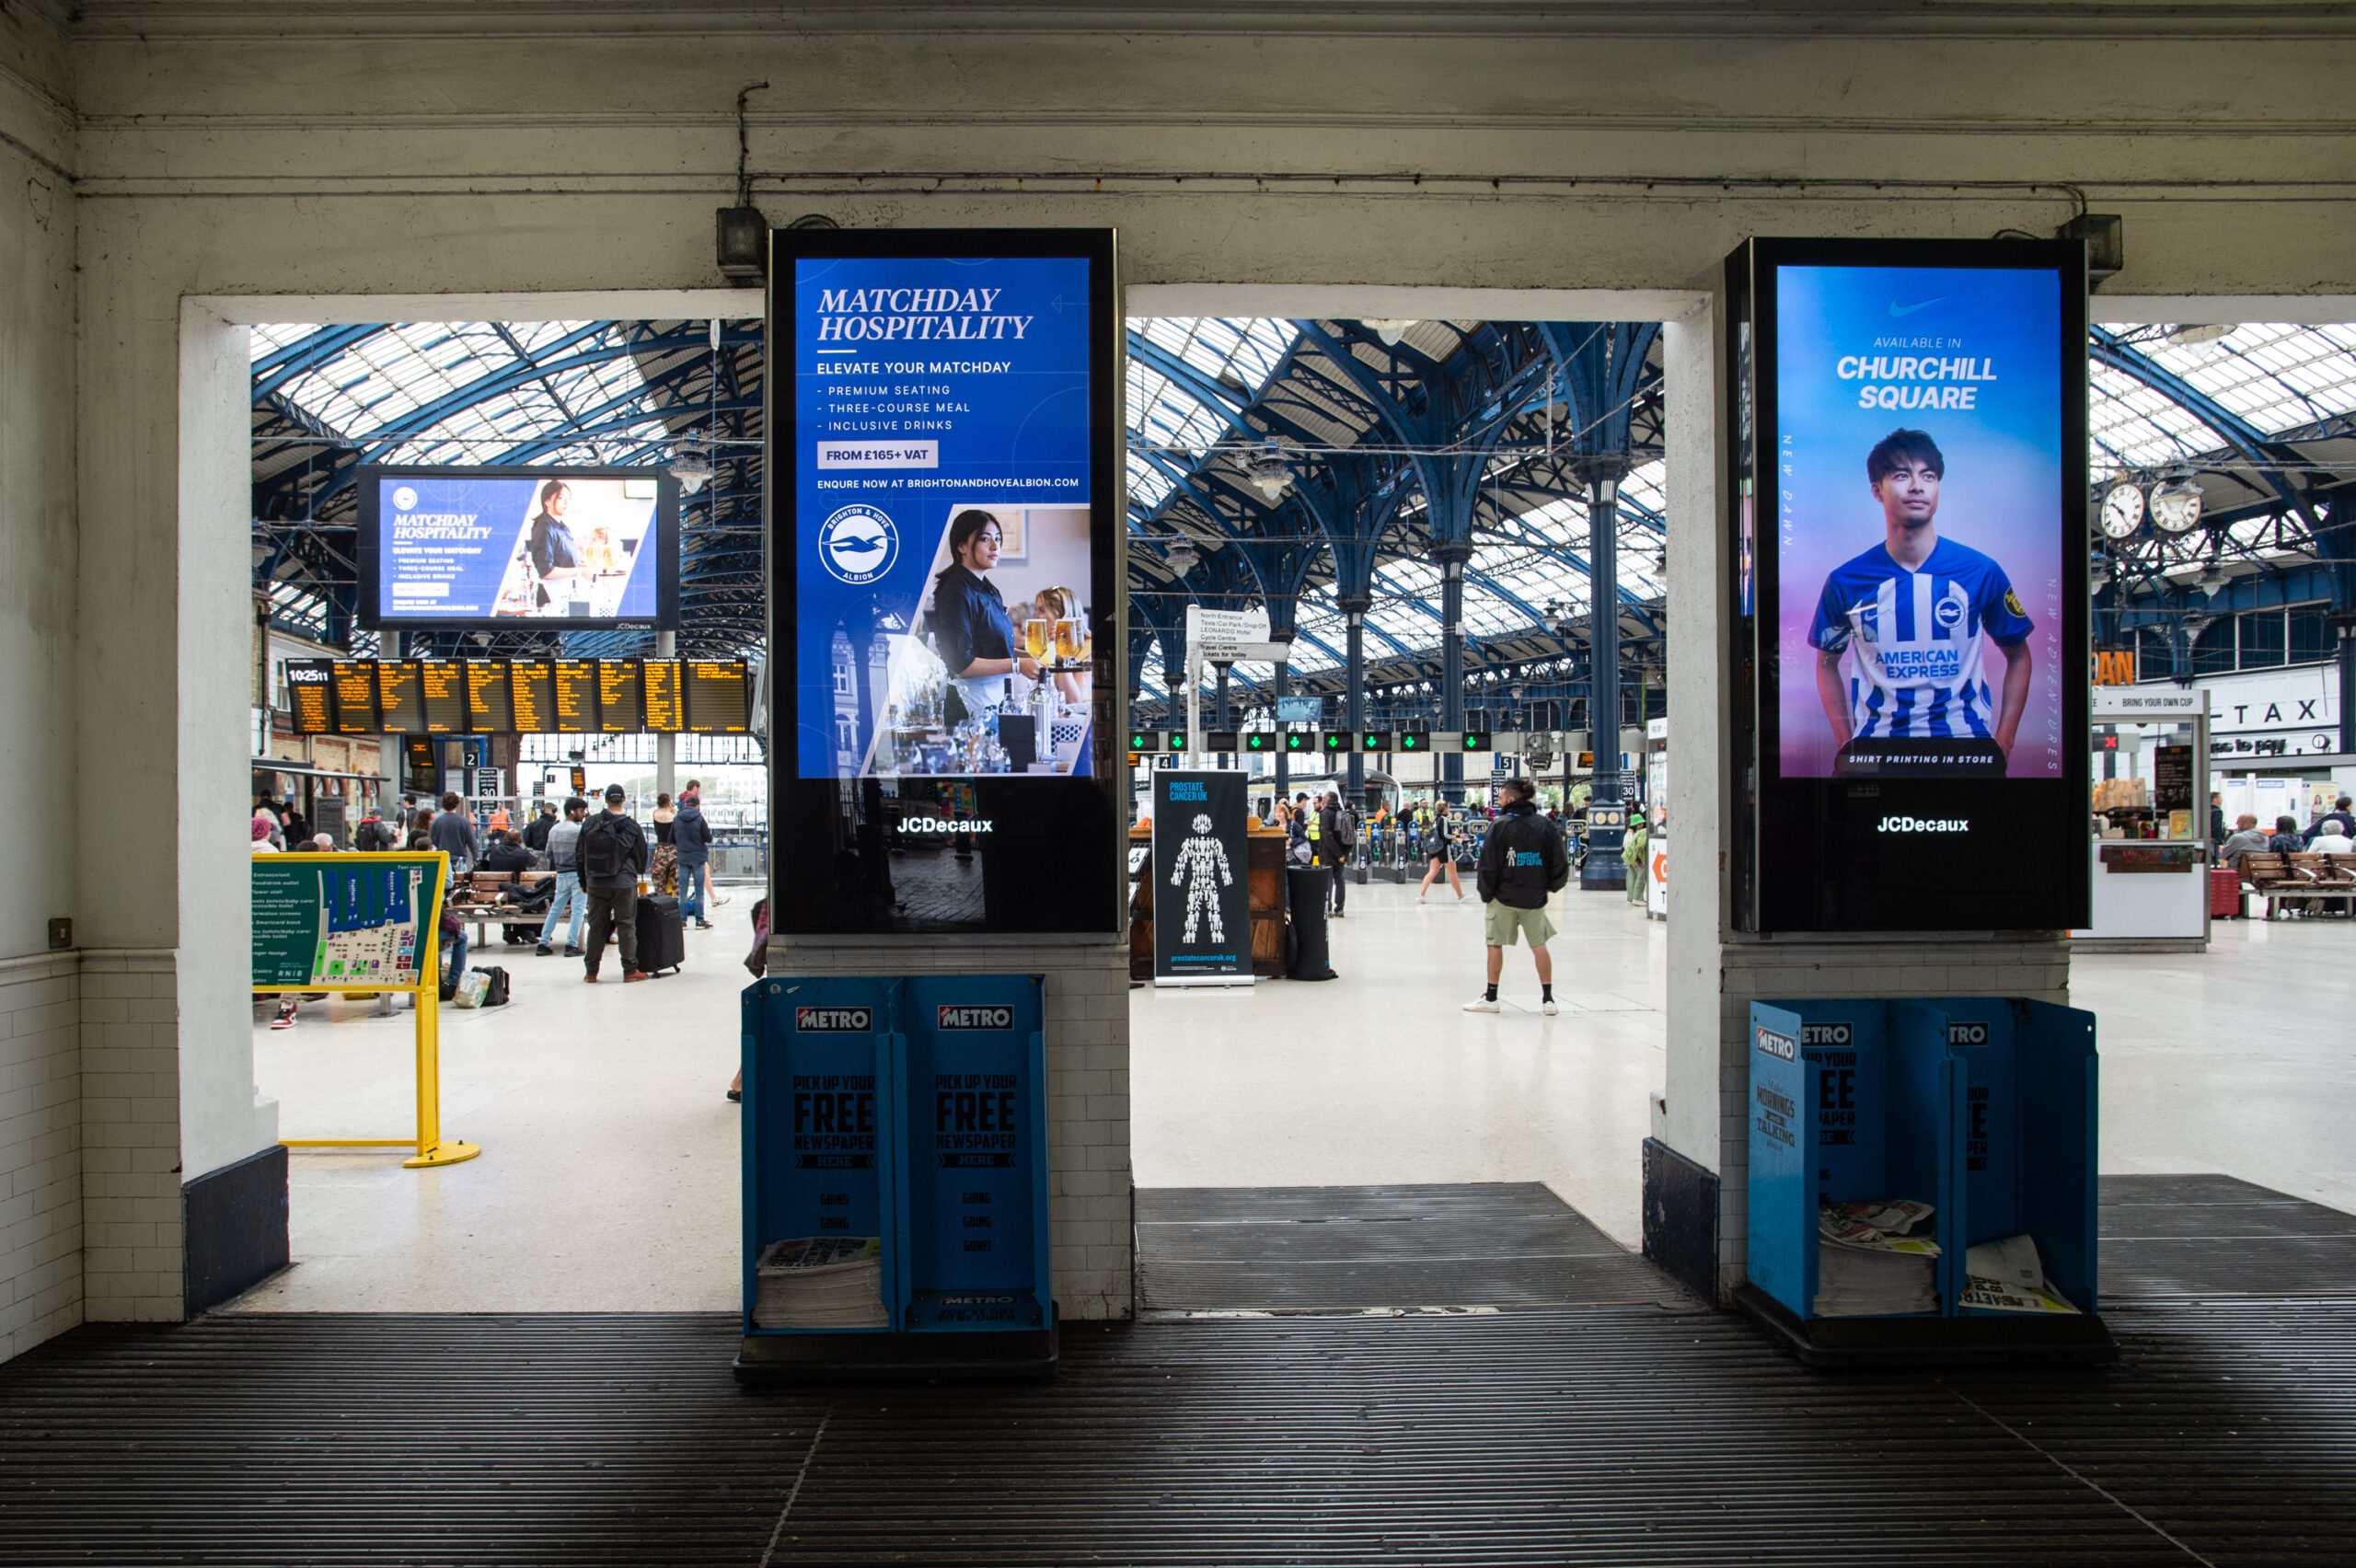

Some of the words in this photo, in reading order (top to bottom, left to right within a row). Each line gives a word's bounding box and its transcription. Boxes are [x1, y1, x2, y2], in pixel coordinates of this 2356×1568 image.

[816, 288, 1000, 313] MATCHDAY
[817, 316, 1034, 340] HOSPITALITY
[1874, 337, 1943, 348] AVAILABLE
[1947, 338, 1961, 348] IN
[817, 363, 879, 375] ELEVATE
[884, 362, 925, 375] YOUR
[930, 361, 1011, 374] MATCHDAY
[1837, 356, 1997, 380] CHURCHILL
[828, 386, 888, 396] PREMIUM
[895, 386, 951, 396] SEATING
[1858, 386, 1978, 409] SQUARE
[828, 403, 930, 413] THREE-COURSE
[936, 402, 970, 412] MEAL
[828, 421, 898, 431] INCLUSIVE
[904, 421, 953, 431] DRINKS
[826, 450, 862, 461] FROM
[864, 450, 901, 461] £165+
[904, 449, 929, 460] VAT
[1782, 435, 1793, 477] NEW
[817, 479, 860, 490] ENQURE
[862, 479, 888, 489] NOW
[891, 479, 905, 489] AT
[907, 478, 1079, 489] BRIGHTONANDHOVEALBION.COM
[393, 513, 478, 526] MATCHDAY
[827, 507, 862, 530] BRIGHTON
[872, 512, 890, 529] HOVE
[393, 526, 492, 539] HOSPITALITY
[842, 571, 873, 581] ALBION
[2047, 579, 2057, 620] NEW
[616, 622, 652, 630] JCDecaux
[1876, 649, 1958, 664] AMERICAN
[1887, 663, 1959, 679] EXPRESS
[2092, 651, 2134, 686] AN
[2047, 632, 2058, 770] ADVENTURES
[2122, 698, 2142, 707] BRING
[2144, 698, 2161, 707] YOUR
[2163, 698, 2178, 707] OWN
[2179, 698, 2194, 707] CUP
[467, 754, 475, 766] 2
[1161, 758, 1169, 768] 4
[1503, 757, 1509, 768] 5
[1849, 755, 1882, 764] SHIRT
[1887, 755, 1938, 764] PRINTING
[1943, 755, 1954, 764] IN
[1958, 755, 1993, 764] STORE
[481, 789, 496, 797] 30
[1170, 782, 1204, 791] PROSTATE
[1623, 787, 1634, 796] 30
[1170, 791, 1197, 801] CANCER
[1197, 791, 1207, 801] UK
[897, 817, 993, 834] JCDecaux
[1877, 816, 1969, 833] JCDecaux
[1171, 953, 1237, 963] prostatecanceruk.org
[801, 1010, 869, 1030] METRO
[941, 1009, 1011, 1028] METRO
[1801, 1025, 1850, 1044] ETRO
[1949, 1025, 1986, 1043] TRO
[1759, 1033, 1794, 1060] METRO
[1824, 1052, 1857, 1067] YOUR
[793, 1076, 821, 1090] PICK
[823, 1076, 839, 1090] UP
[842, 1075, 875, 1090] YOUR
[935, 1075, 963, 1089] PICK
[964, 1075, 981, 1089] UP
[983, 1074, 1017, 1089] YOUR
[1819, 1069, 1856, 1110] EE
[1967, 1088, 1989, 1101] OUR
[1756, 1085, 1796, 1119] MORNINGS
[794, 1092, 874, 1133] FREE
[936, 1091, 1016, 1132] FREE
[1756, 1117, 1796, 1147] TALKING
[794, 1136, 875, 1150] NEWSPAPER
[936, 1134, 1016, 1149] NEWSPAPER
[817, 1157, 852, 1167] HERE
[958, 1155, 994, 1166] HERE
[820, 1193, 849, 1205] GOING
[963, 1192, 992, 1205] GOING
[820, 1216, 849, 1229] GOING
[963, 1216, 992, 1228] GOING
[964, 1239, 991, 1251] GONE!
[945, 1297, 1014, 1305] METRO
